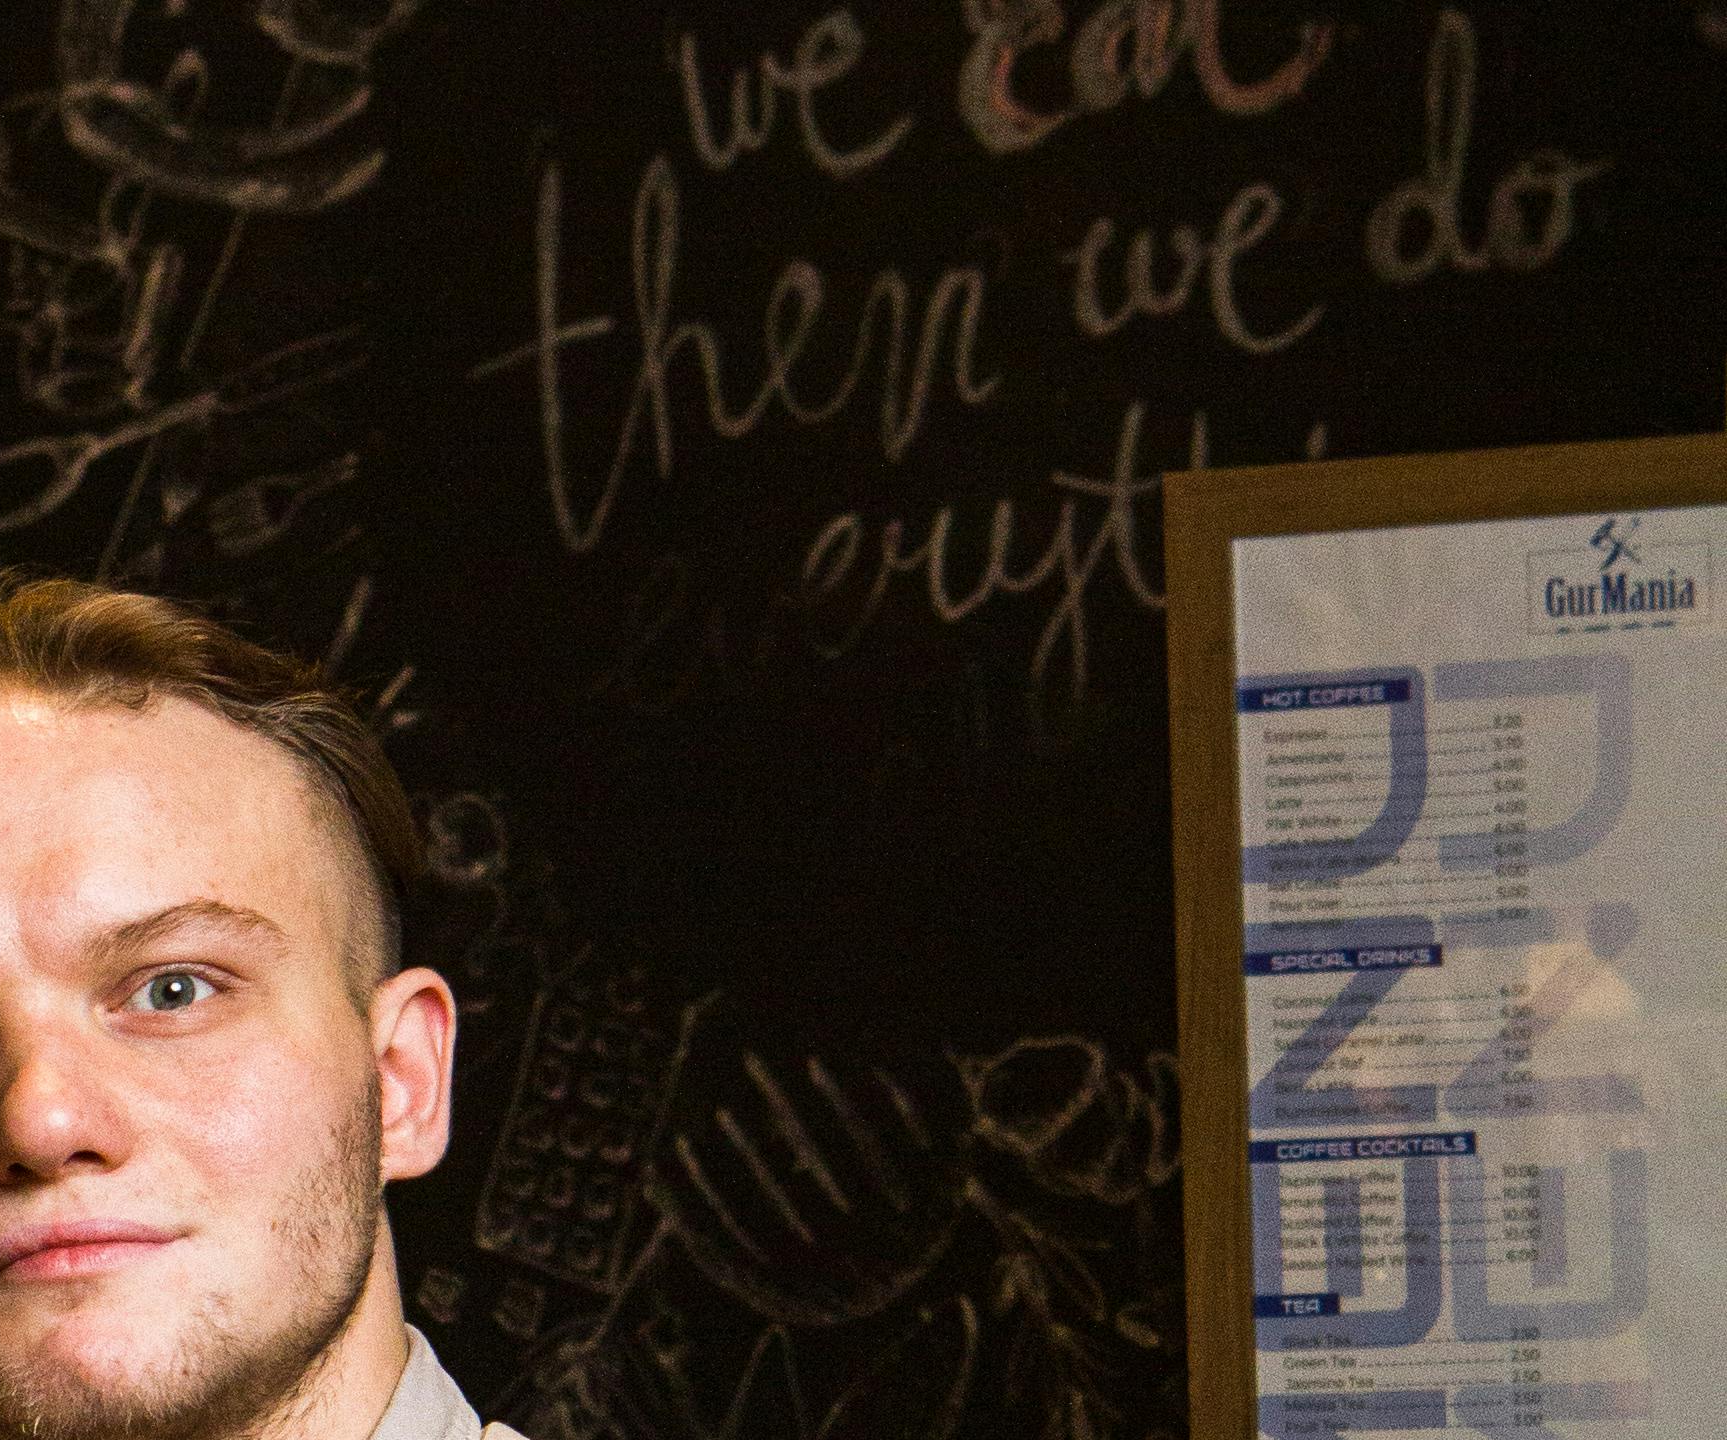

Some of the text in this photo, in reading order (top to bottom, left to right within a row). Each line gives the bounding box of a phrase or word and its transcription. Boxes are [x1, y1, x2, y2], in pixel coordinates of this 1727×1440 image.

[672, 10, 912, 178] we
[472, 12, 1614, 553] then we do
[1543, 567, 1696, 618] GurMania
[1263, 686, 1385, 706] HOT COFFEE
[1271, 949, 1432, 972] SPECIAL DRINKS
[1276, 1136, 1468, 1160] COFFEE COCKTAILS
[1281, 1299, 1321, 1314] TEA
[1283, 1355, 1326, 1371] Green
[1329, 1354, 1357, 1368] Tea
[1344, 1374, 1375, 1389] Tea
